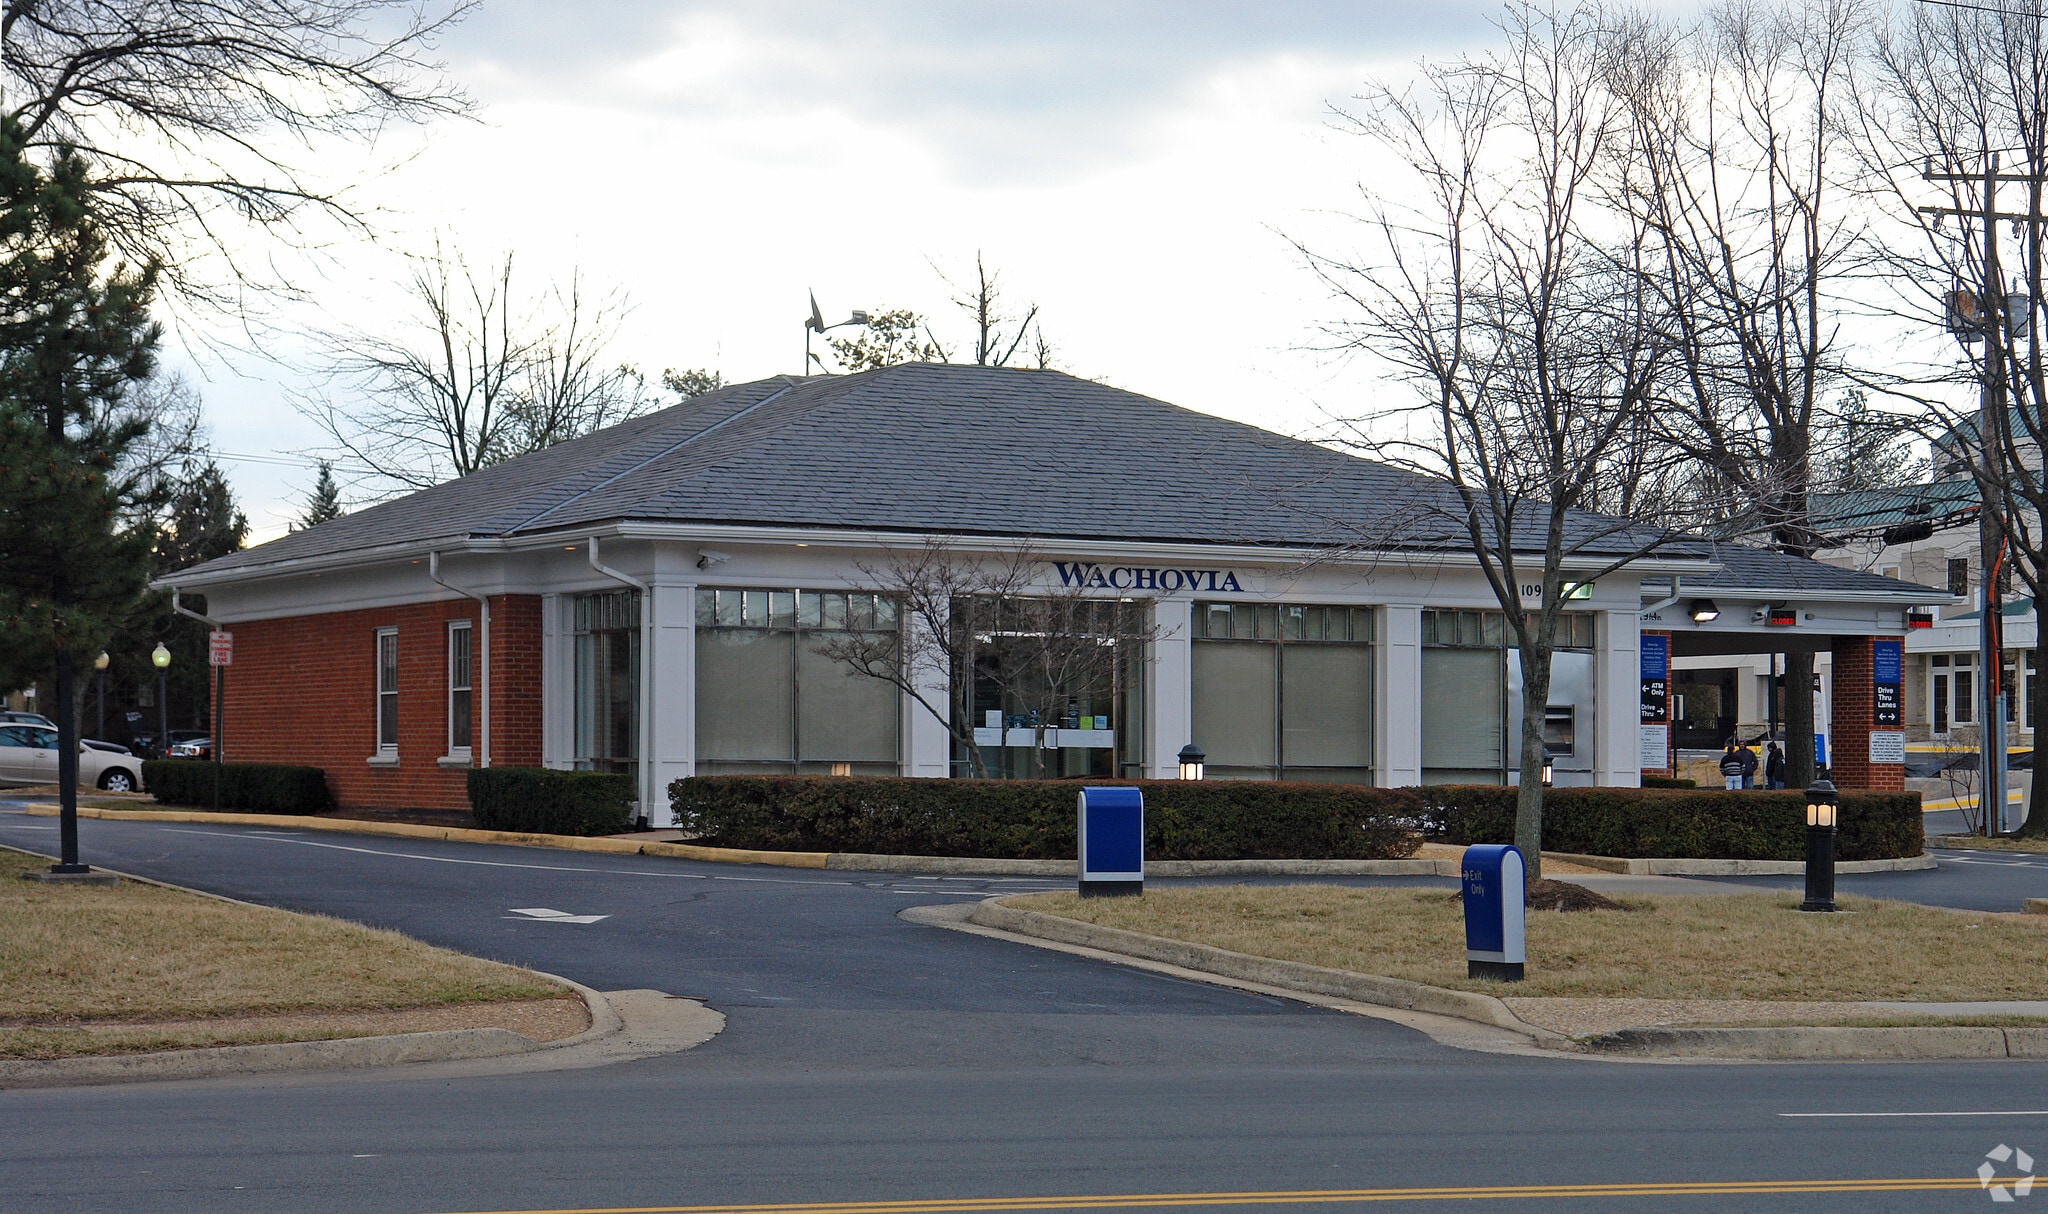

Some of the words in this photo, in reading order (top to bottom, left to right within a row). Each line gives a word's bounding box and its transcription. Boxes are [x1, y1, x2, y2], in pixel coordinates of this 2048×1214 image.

[1052, 561, 1244, 592] WACHOVIA
[1521, 584, 1542, 597] 109
[1771, 617, 1795, 625] CLOSED
[1877, 686, 1894, 694] Drive
[1877, 701, 1897, 709] Lanes
[1470, 869, 1482, 881] Exit
[1471, 883, 1485, 897] Only
